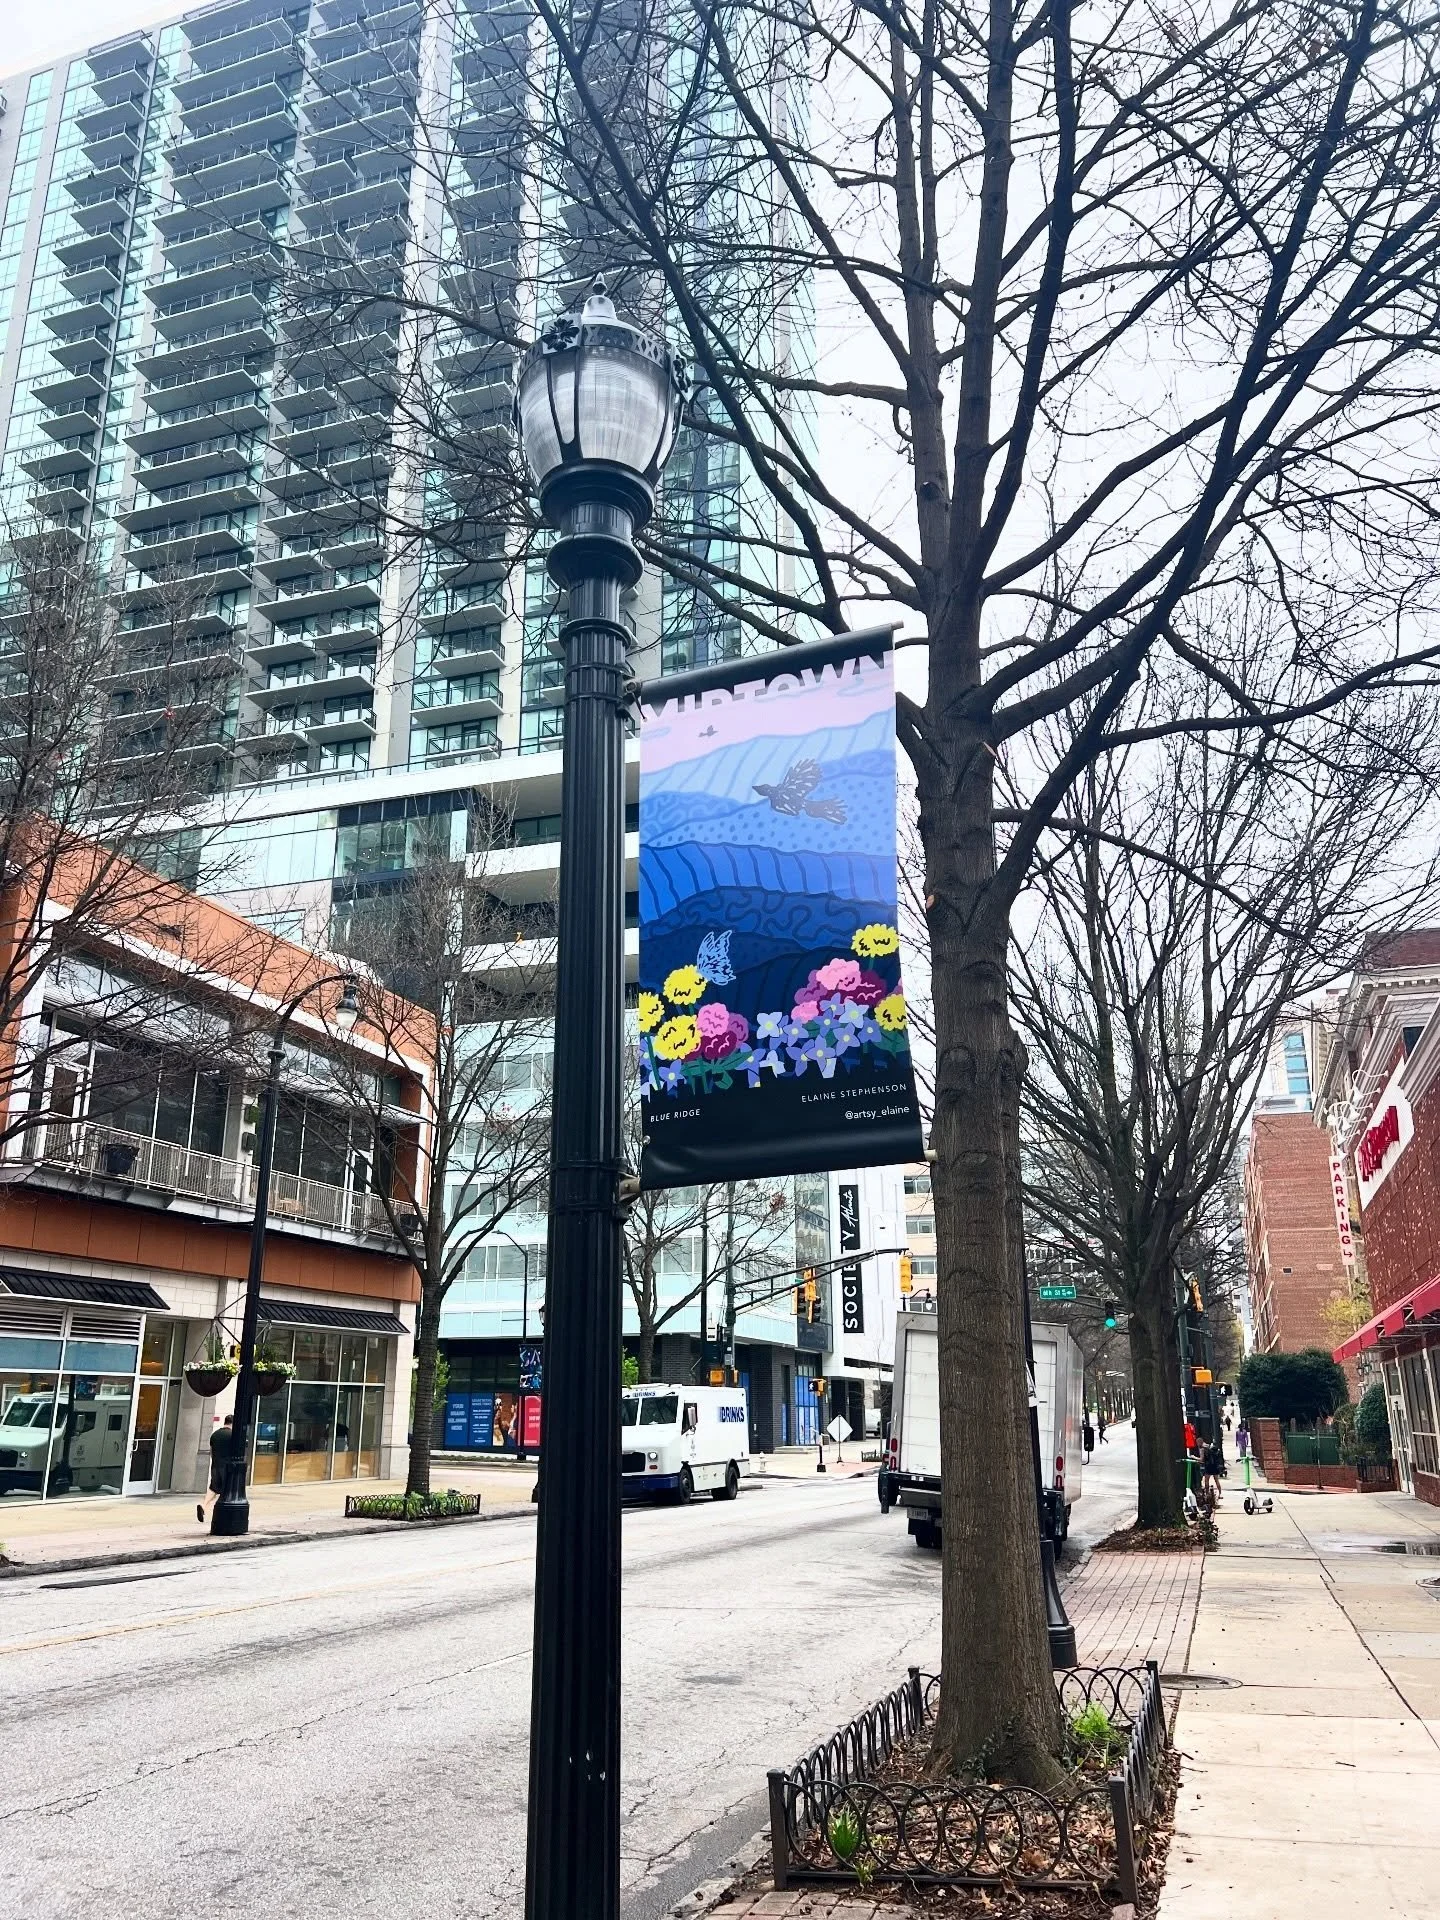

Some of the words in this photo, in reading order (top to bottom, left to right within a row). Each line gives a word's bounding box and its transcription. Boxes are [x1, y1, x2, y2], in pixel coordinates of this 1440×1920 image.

[801, 1091, 836, 1103] ELAINE
[840, 1083, 907, 1098] STEPHENSON
[650, 1112, 671, 1123] BLUE
[673, 1108, 701, 1119] RIDGE
[844, 1105, 910, 1120] @artsy_elaine
[1332, 1162, 1351, 1245] PARKING
